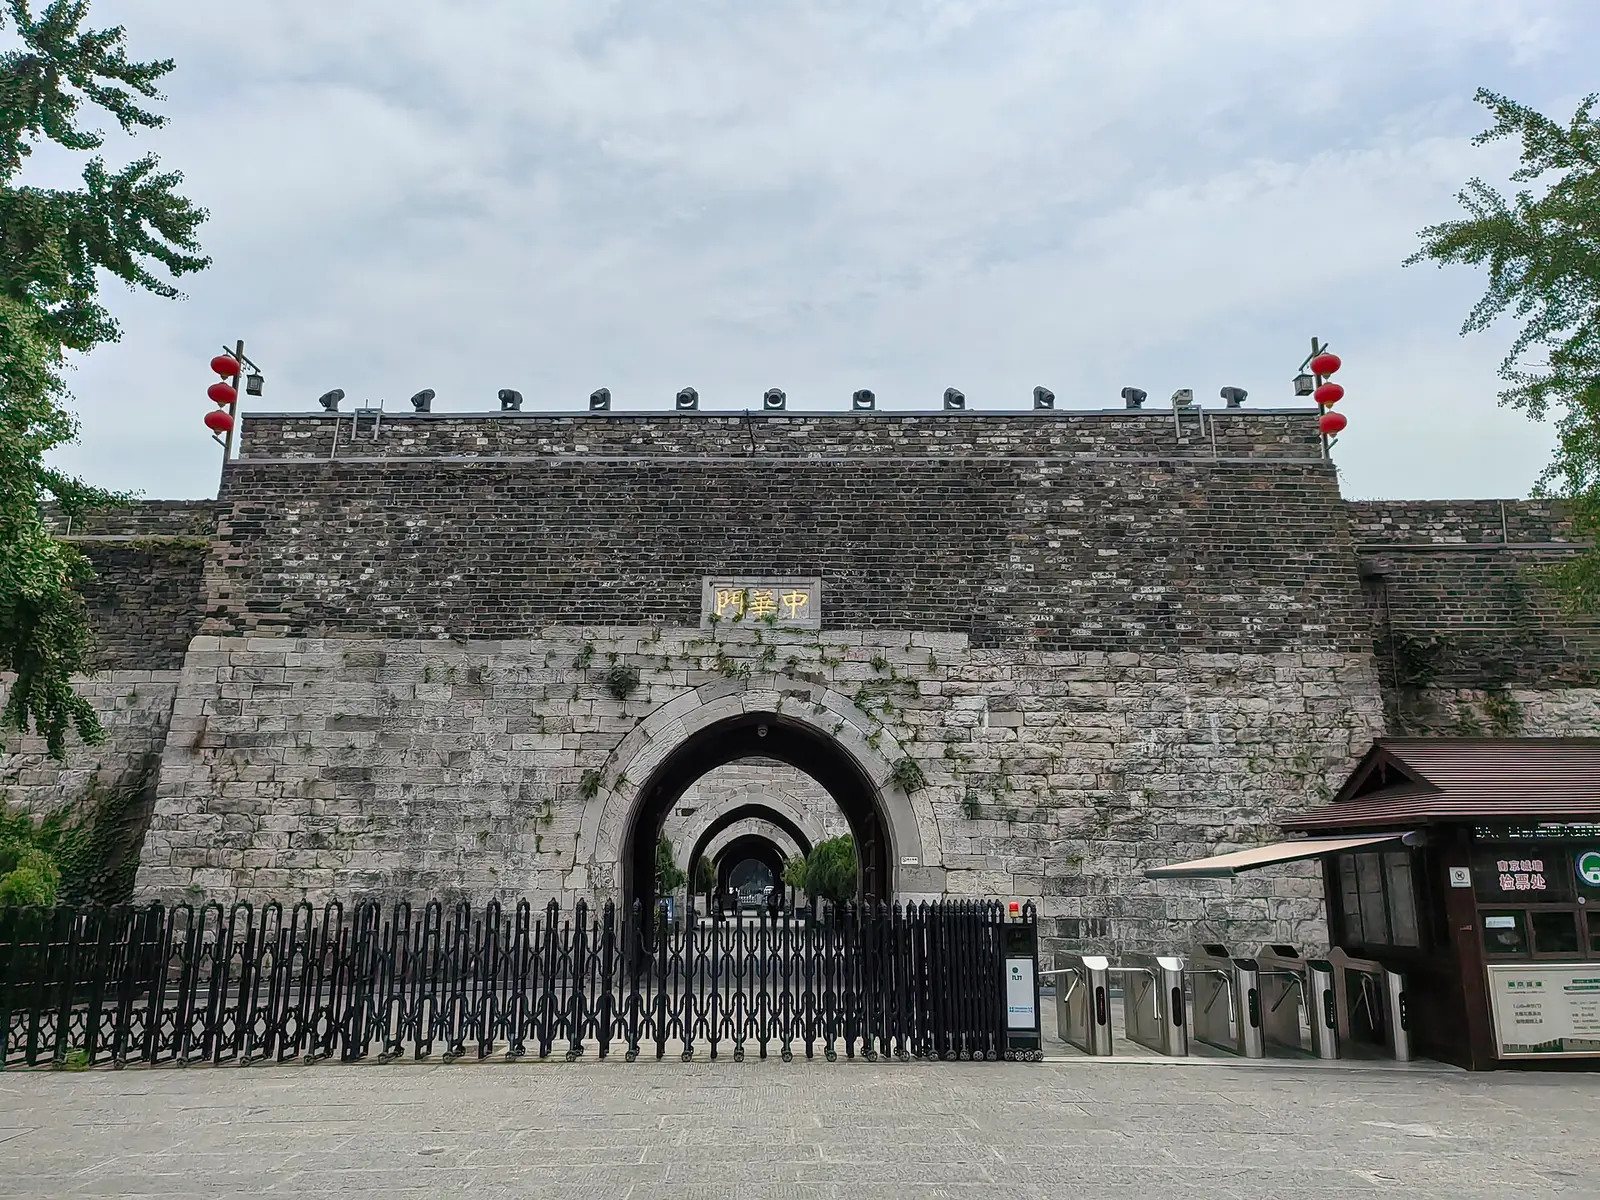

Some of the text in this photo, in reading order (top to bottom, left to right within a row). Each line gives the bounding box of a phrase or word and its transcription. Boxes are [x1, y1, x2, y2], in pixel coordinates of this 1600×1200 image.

[1497, 860, 1544, 872] 南京城墙
[1499, 874, 1546, 890] 检票处
